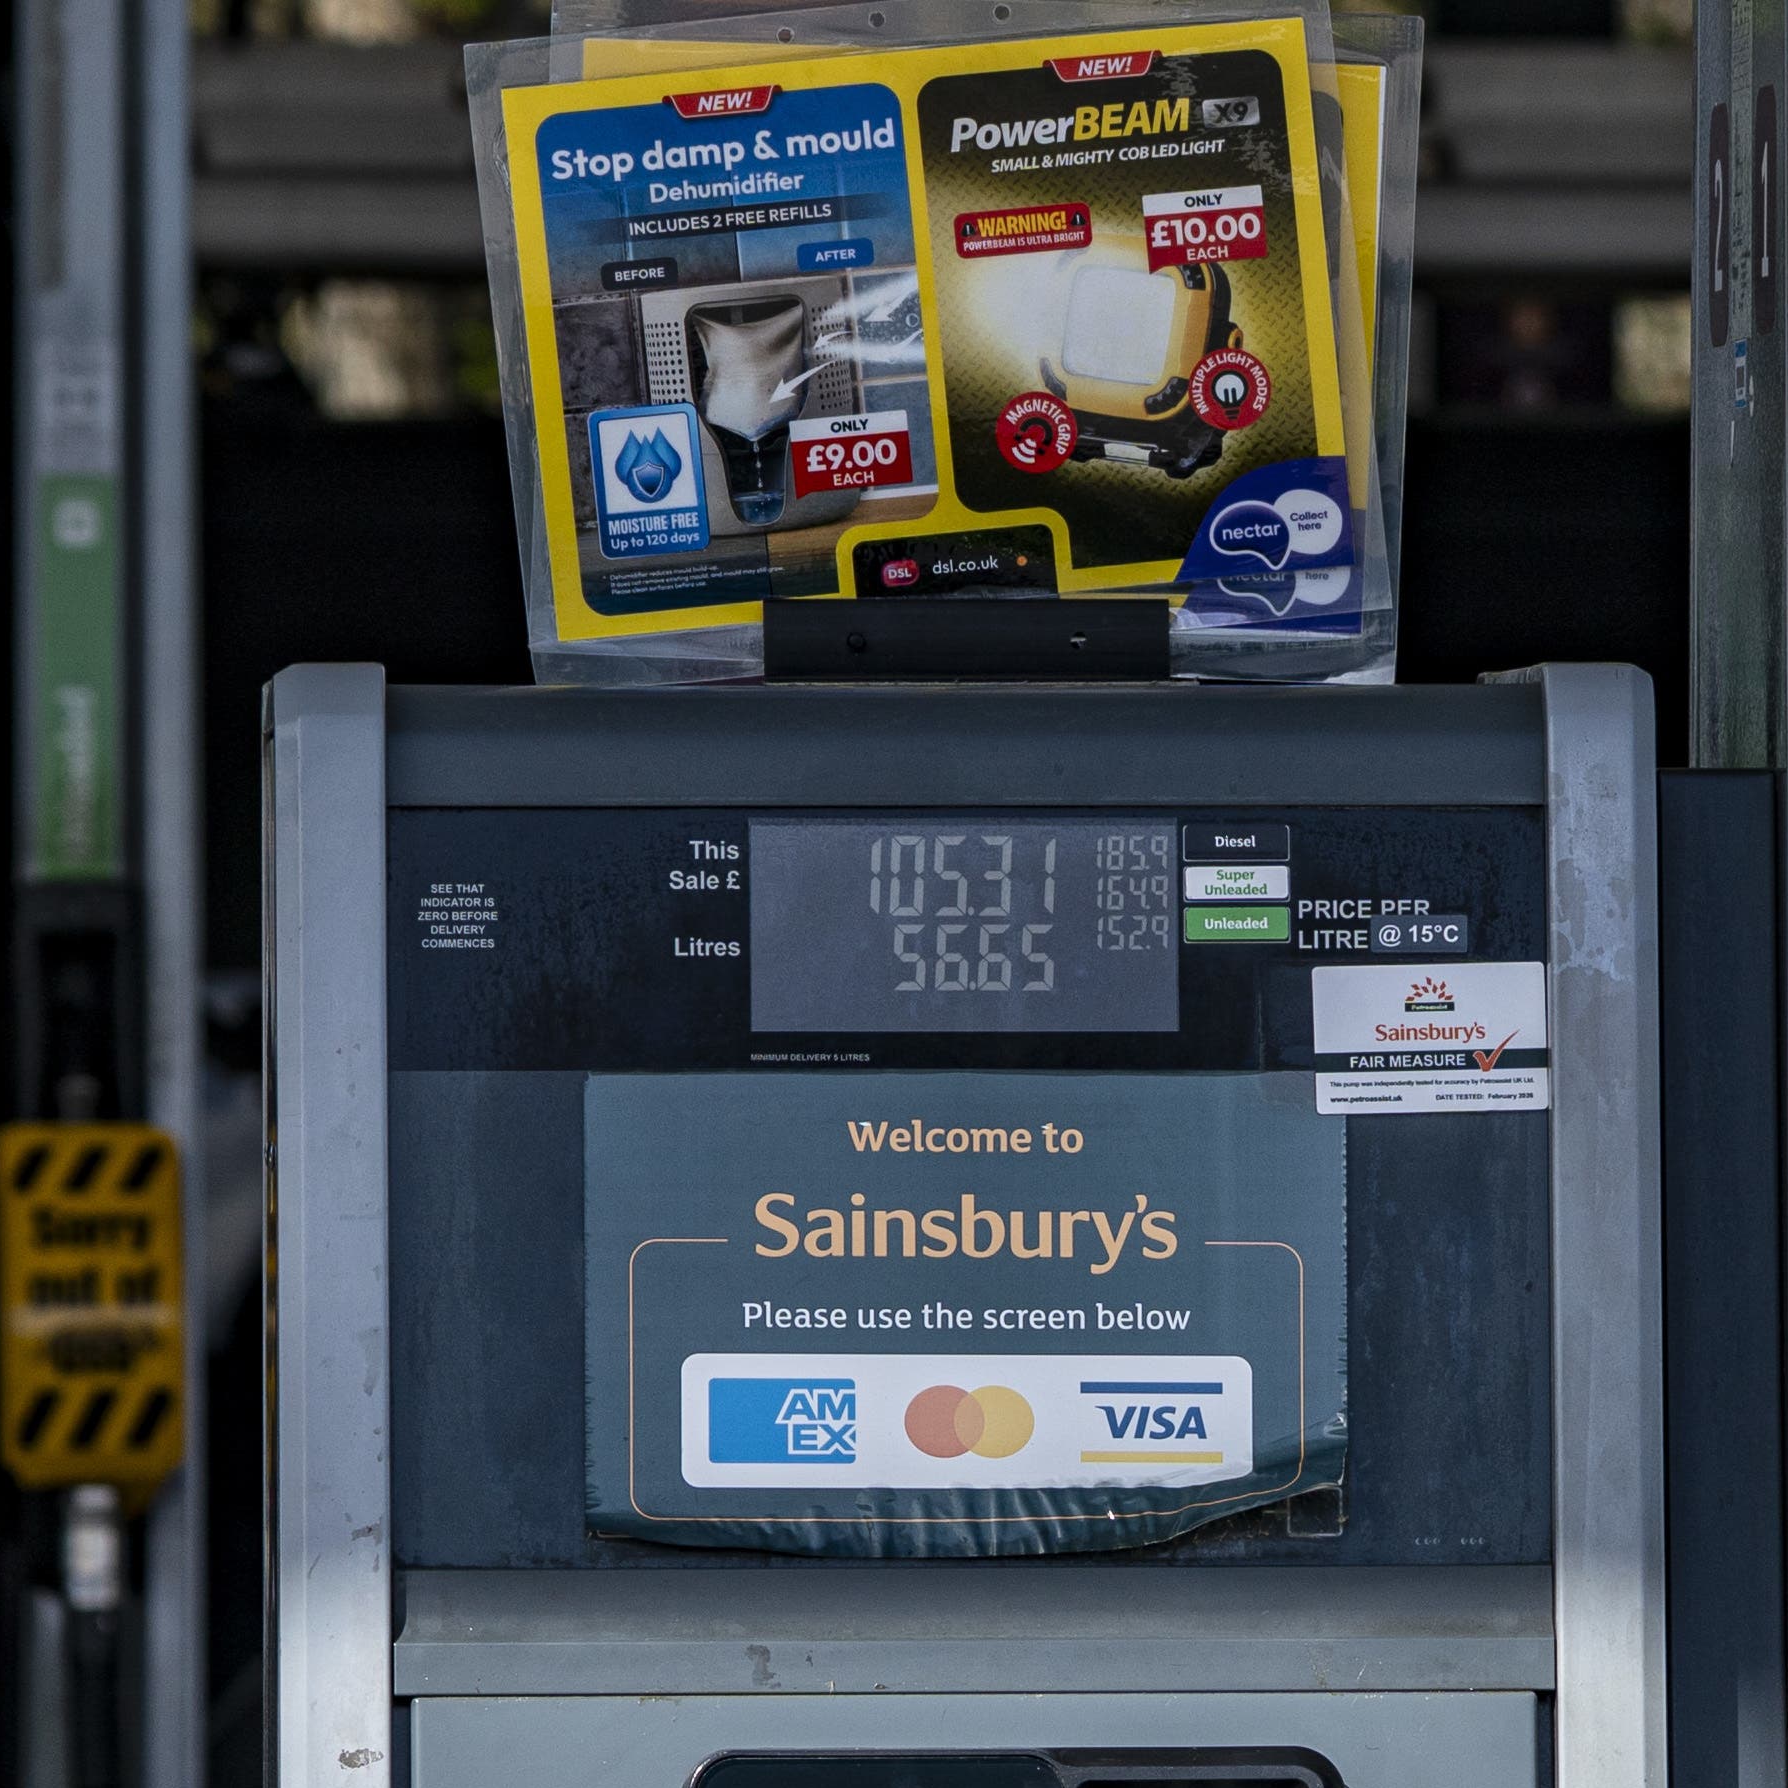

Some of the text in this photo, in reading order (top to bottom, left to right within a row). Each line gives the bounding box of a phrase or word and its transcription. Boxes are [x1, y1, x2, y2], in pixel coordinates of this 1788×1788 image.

[1078, 56, 1132, 76] NEW!
[697, 91, 752, 112] NEW!
[951, 97, 1249, 152] PowerBEAM X9
[551, 118, 895, 181] Stop damp & mould
[991, 139, 1225, 173] SMALL & MIGHTY COB LED LIGHT
[649, 172, 804, 203] Dehumidifier
[1184, 193, 1222, 208] ONLY
[629, 204, 832, 236] INCLUDES 2 FREE REFILLS
[977, 211, 1067, 238] WARNING!
[1151, 212, 1261, 248] £10.00
[815, 248, 855, 262] AFTER
[1186, 246, 1229, 261] EACH
[614, 266, 665, 282] BEFORE
[830, 418, 868, 432] ONLY
[806, 438, 897, 473] £9.00
[833, 471, 875, 486] EACH
[608, 512, 699, 536] MOISTURE FREE
[1222, 522, 1280, 541] nectar
[887, 567, 911, 579] DSL
[932, 555, 999, 575] dsl.co.uk
[689, 840, 739, 860] This
[1215, 835, 1256, 848] Diesel
[669, 871, 740, 890] Sale £
[1216, 869, 1254, 883] Super
[430, 884, 485, 893] SEE THAT
[1204, 883, 1268, 896] Unleaded
[420, 898, 494, 907] INDICATOR IS
[1299, 899, 1429, 919] PRICE PER
[418, 912, 498, 921] ZERO BEFORE
[1204, 917, 1268, 930] Unleaded
[430, 925, 485, 934] DELIVERY
[1379, 925, 1458, 945] @ 15°C
[422, 939, 494, 948] COMMENCES
[674, 938, 740, 957] Litres
[1299, 931, 1368, 949] LITRE
[1376, 1022, 1485, 1043] Sainsbury's
[1350, 1054, 1466, 1068] FAIR MEASURE
[848, 1120, 1083, 1154] Welcome to
[754, 1192, 1178, 1274] Sainsbury's
[742, 1302, 1190, 1331] Please use the screen below
[1094, 1406, 1207, 1439] VISA
